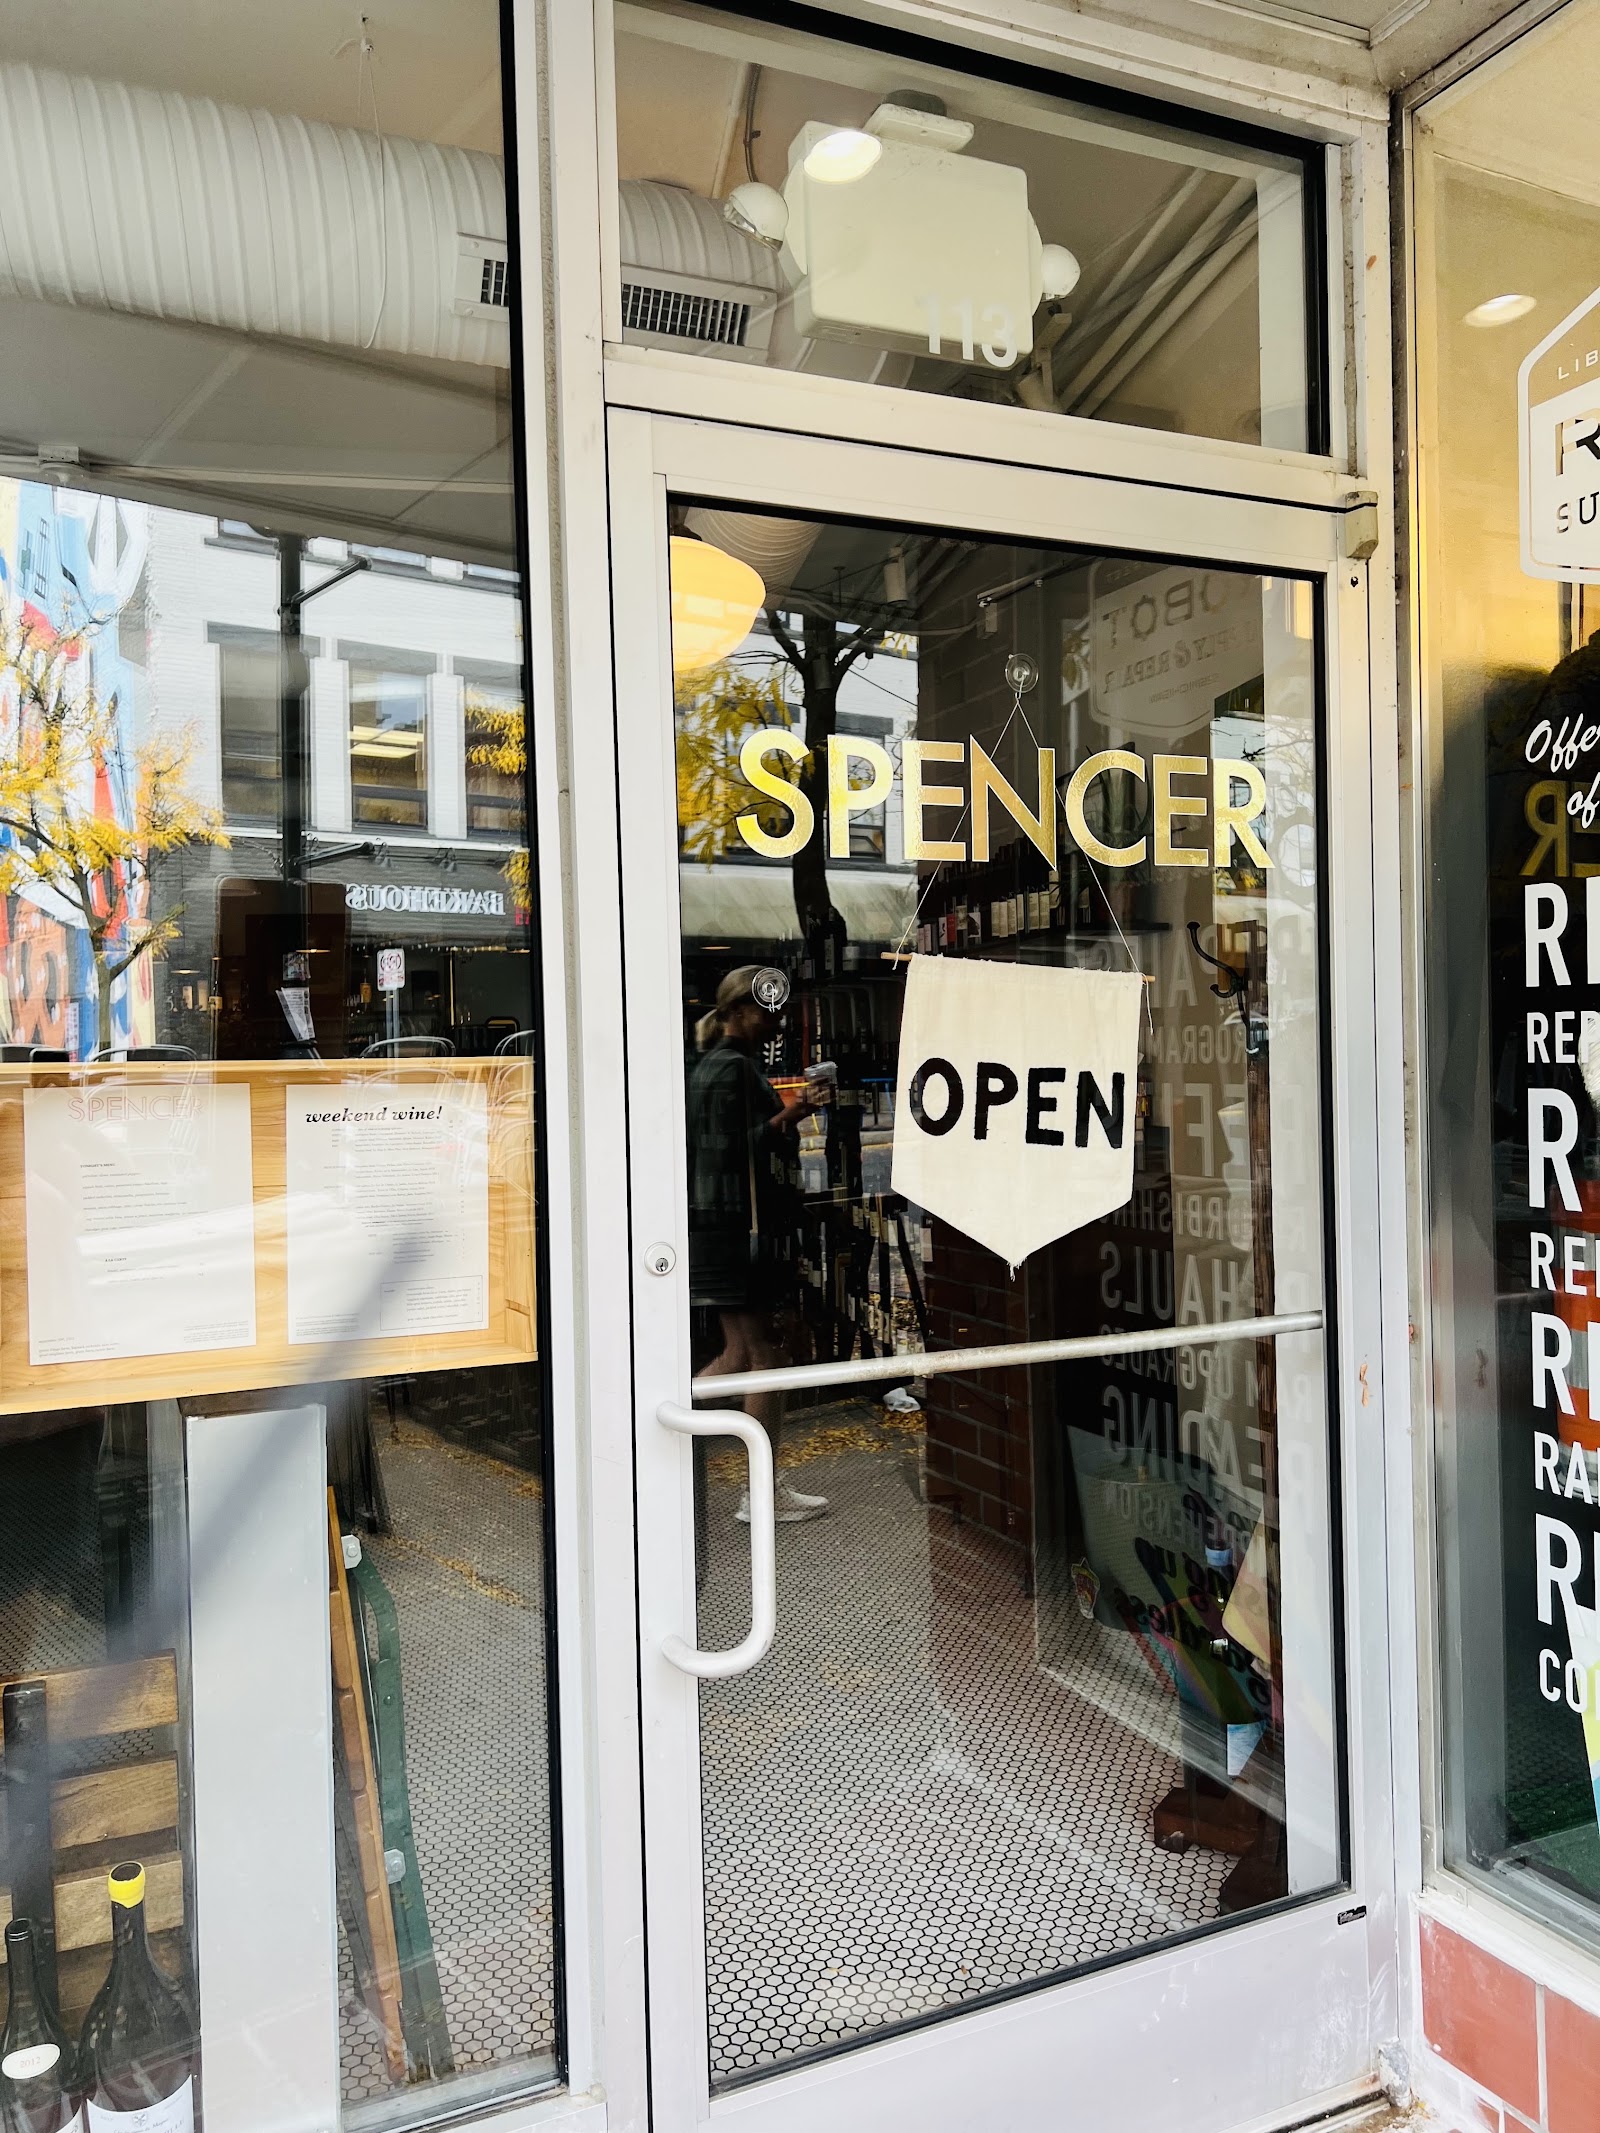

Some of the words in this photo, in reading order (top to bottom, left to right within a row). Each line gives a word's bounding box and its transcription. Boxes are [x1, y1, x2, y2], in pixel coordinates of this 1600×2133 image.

[918, 294, 1018, 368] 113
[736, 728, 1276, 871] SPENCER
[306, 1107, 388, 1123] weekend
[392, 1105, 443, 1121] wine!
[909, 1057, 1125, 1149] OPEN
[1530, 1232, 1600, 1298] RE
[1534, 1431, 1600, 1507] RA
[1535, 1513, 1600, 1642] R
[1539, 1648, 1600, 1721] CO
[20, 2056, 41, 2068] 2012
